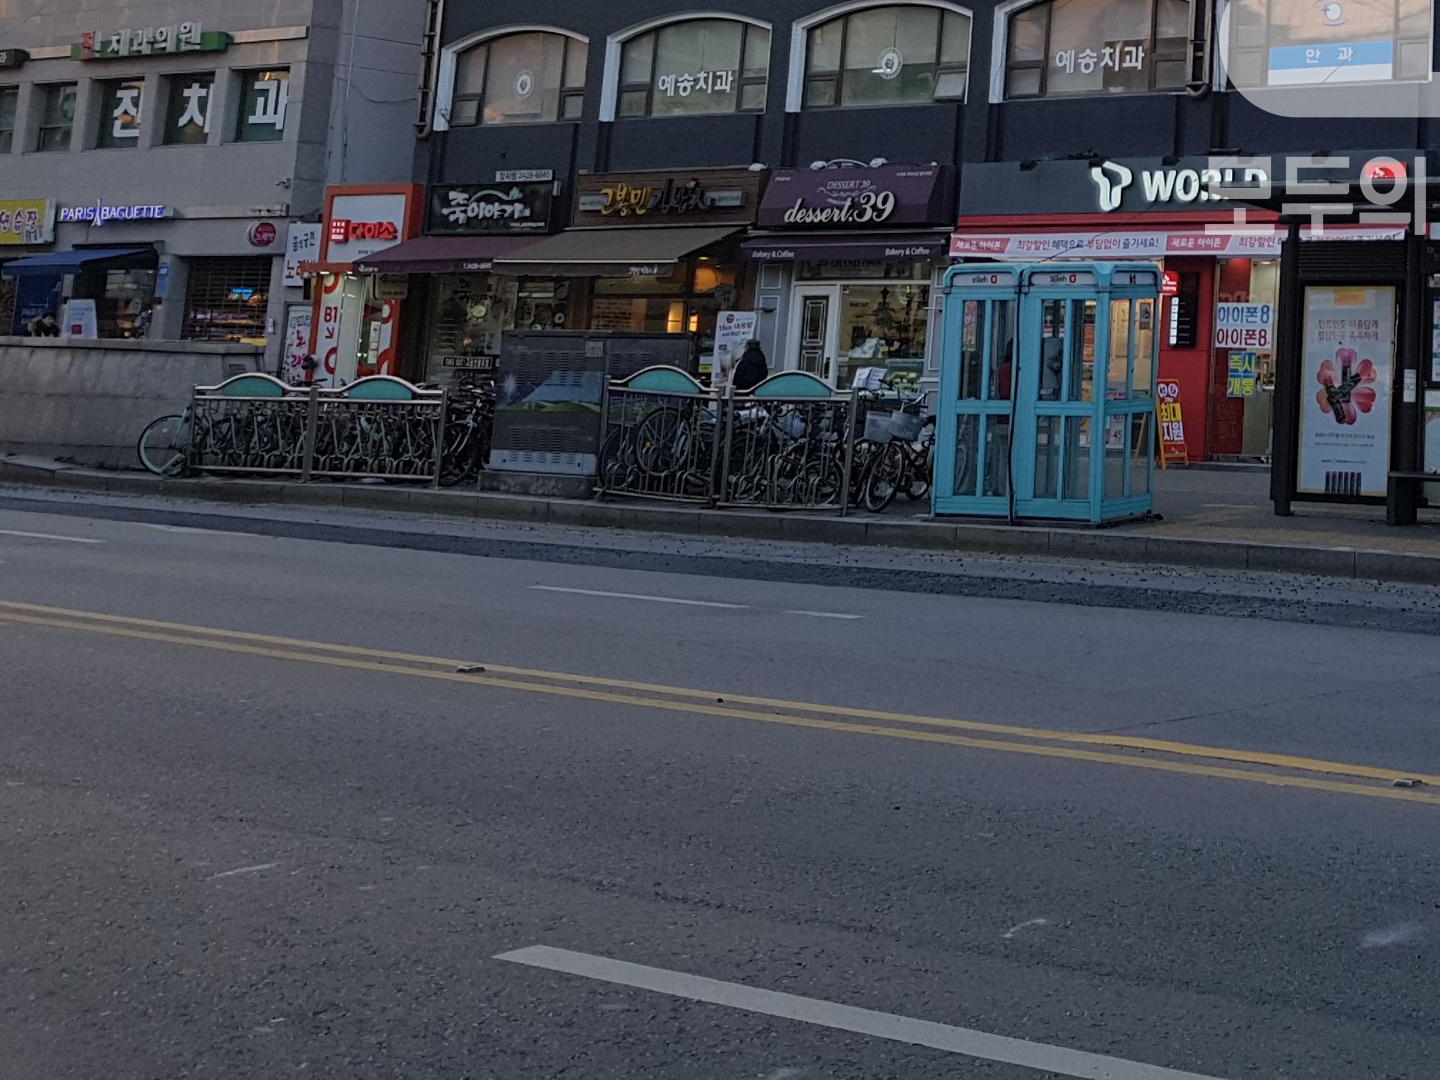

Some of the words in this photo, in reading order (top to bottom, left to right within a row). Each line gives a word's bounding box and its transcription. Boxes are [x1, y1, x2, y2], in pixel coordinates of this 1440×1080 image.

[1056, 46, 1145, 74] 예송치과
[658, 70, 734, 97] 예송치과
[61, 208, 93, 221] PARIS
[101, 206, 165, 220] BAGUETTE
[350, 222, 398, 240] 다이소
[325, 307, 338, 322] B1
[1218, 305, 1270, 324] 아이폰8
